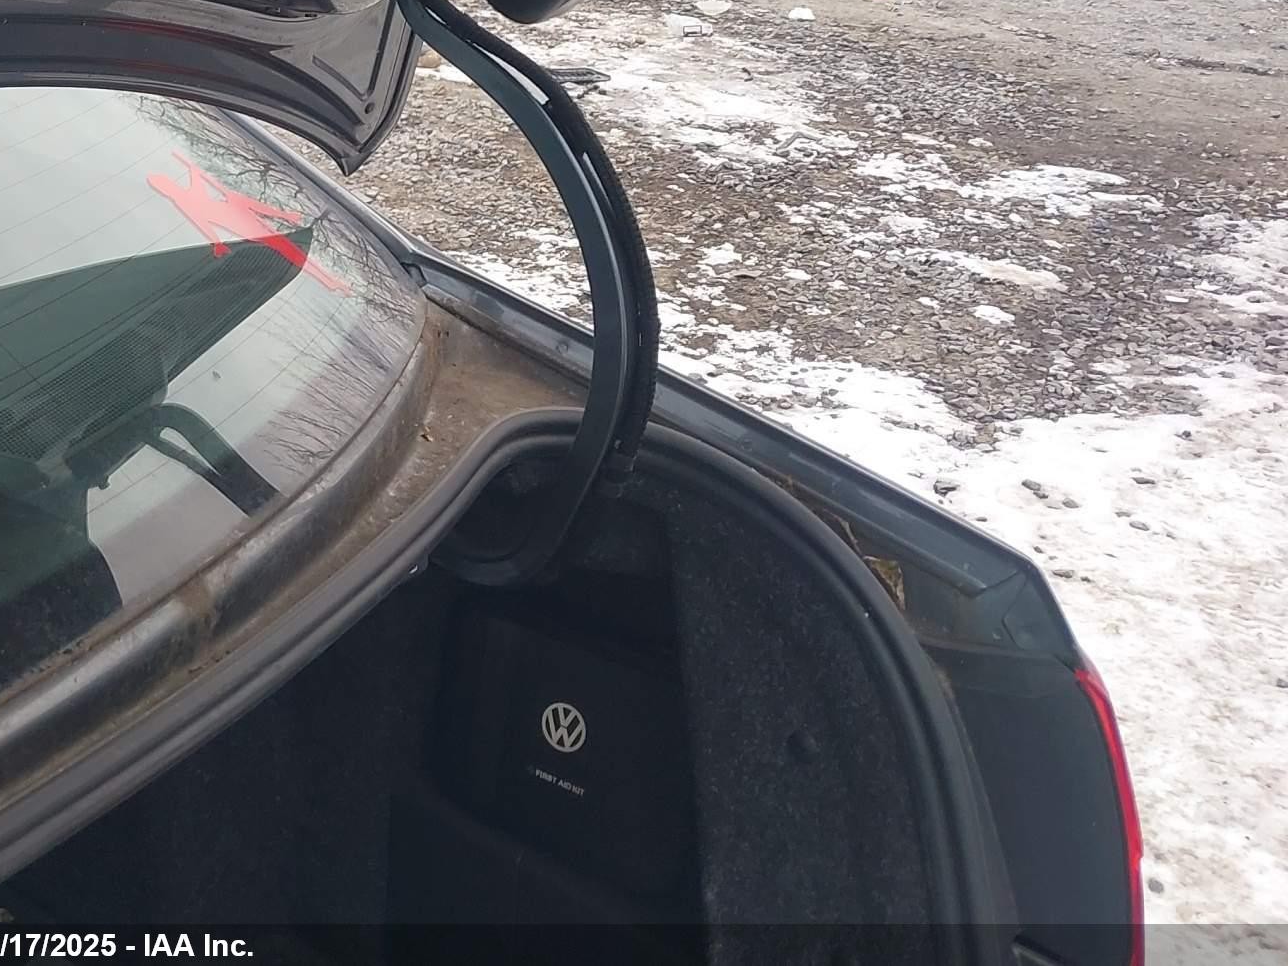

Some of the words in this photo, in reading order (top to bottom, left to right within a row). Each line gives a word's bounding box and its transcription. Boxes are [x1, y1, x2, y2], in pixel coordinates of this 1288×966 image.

[535, 769, 557, 784] FIRST
[557, 779, 572, 791] AID
[572, 785, 585, 797] KIT
